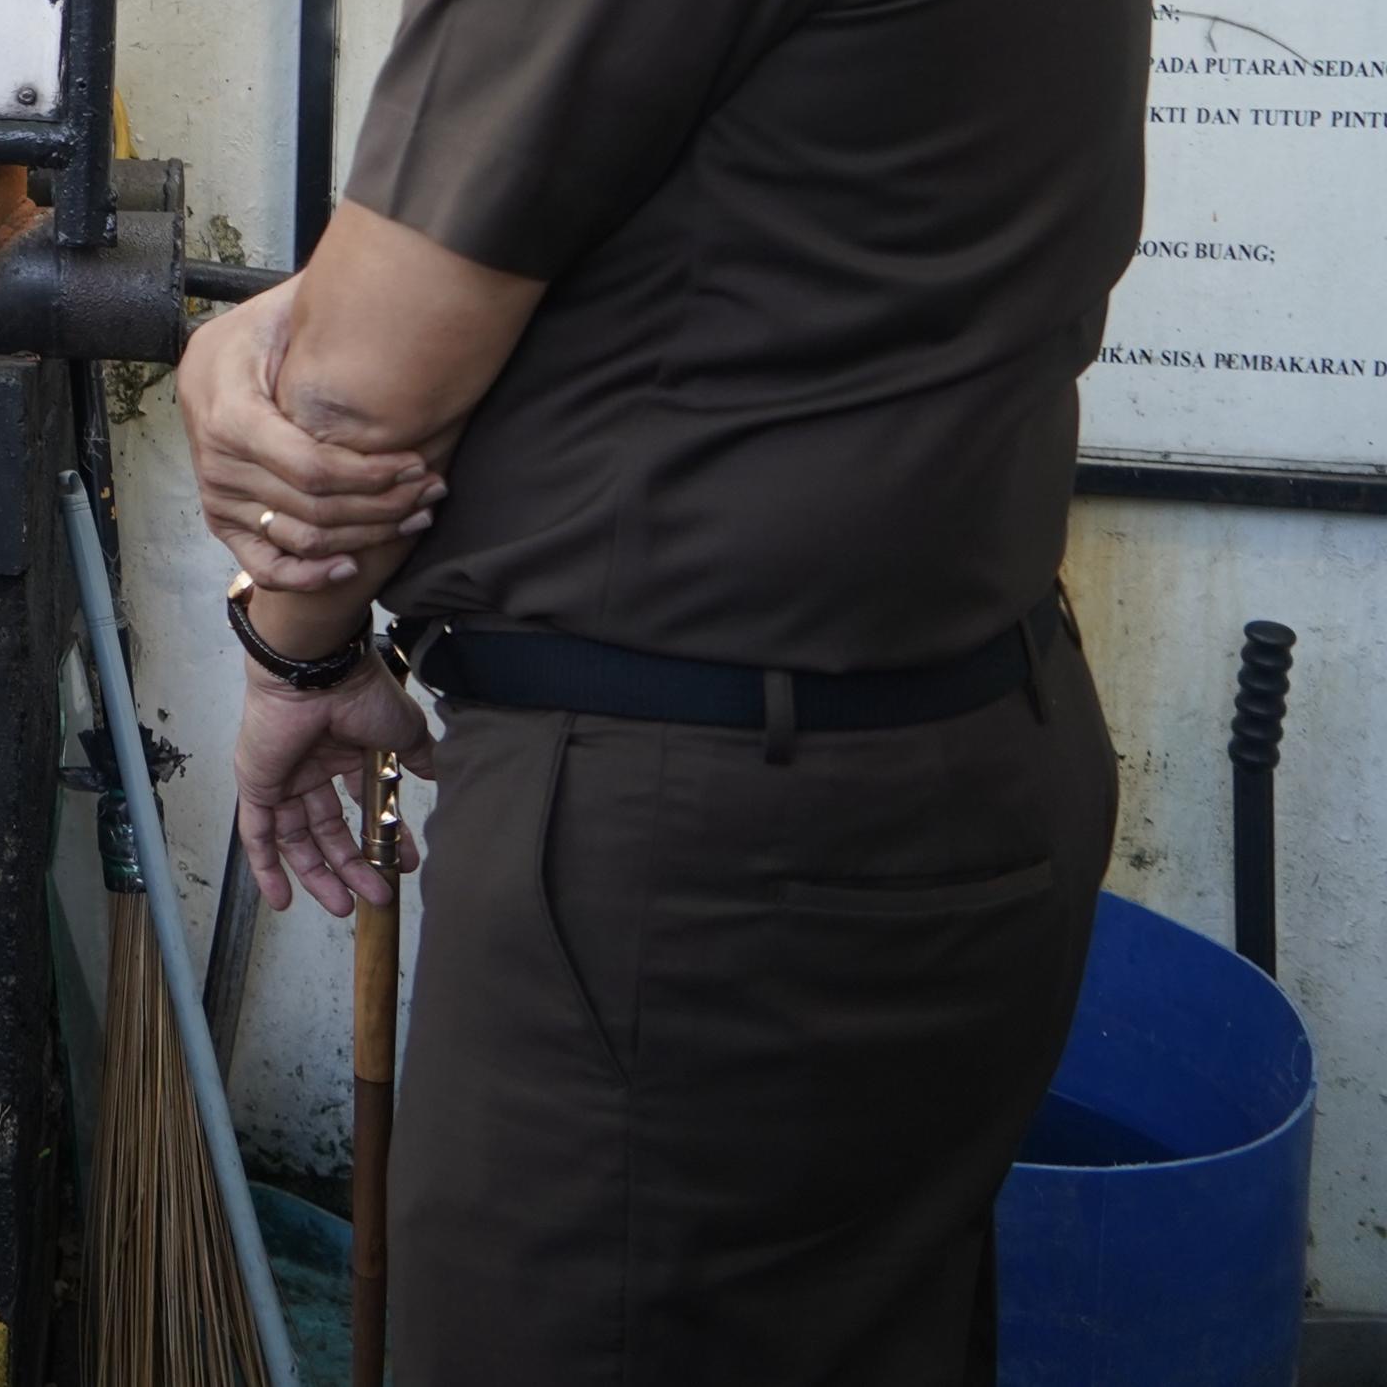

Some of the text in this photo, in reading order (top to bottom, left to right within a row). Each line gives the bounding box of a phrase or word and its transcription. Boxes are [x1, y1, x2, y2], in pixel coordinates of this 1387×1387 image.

[1205, 58, 1306, 77] PUTARAN
[1313, 59, 1387, 79] SEDAN
[1196, 108, 1241, 126] DAN
[1250, 109, 1322, 128] TUTUP
[1194, 242, 1275, 265] BUANG;
[1161, 350, 1206, 369] SISA
[1214, 353, 1366, 377] PEMBAKARAN
